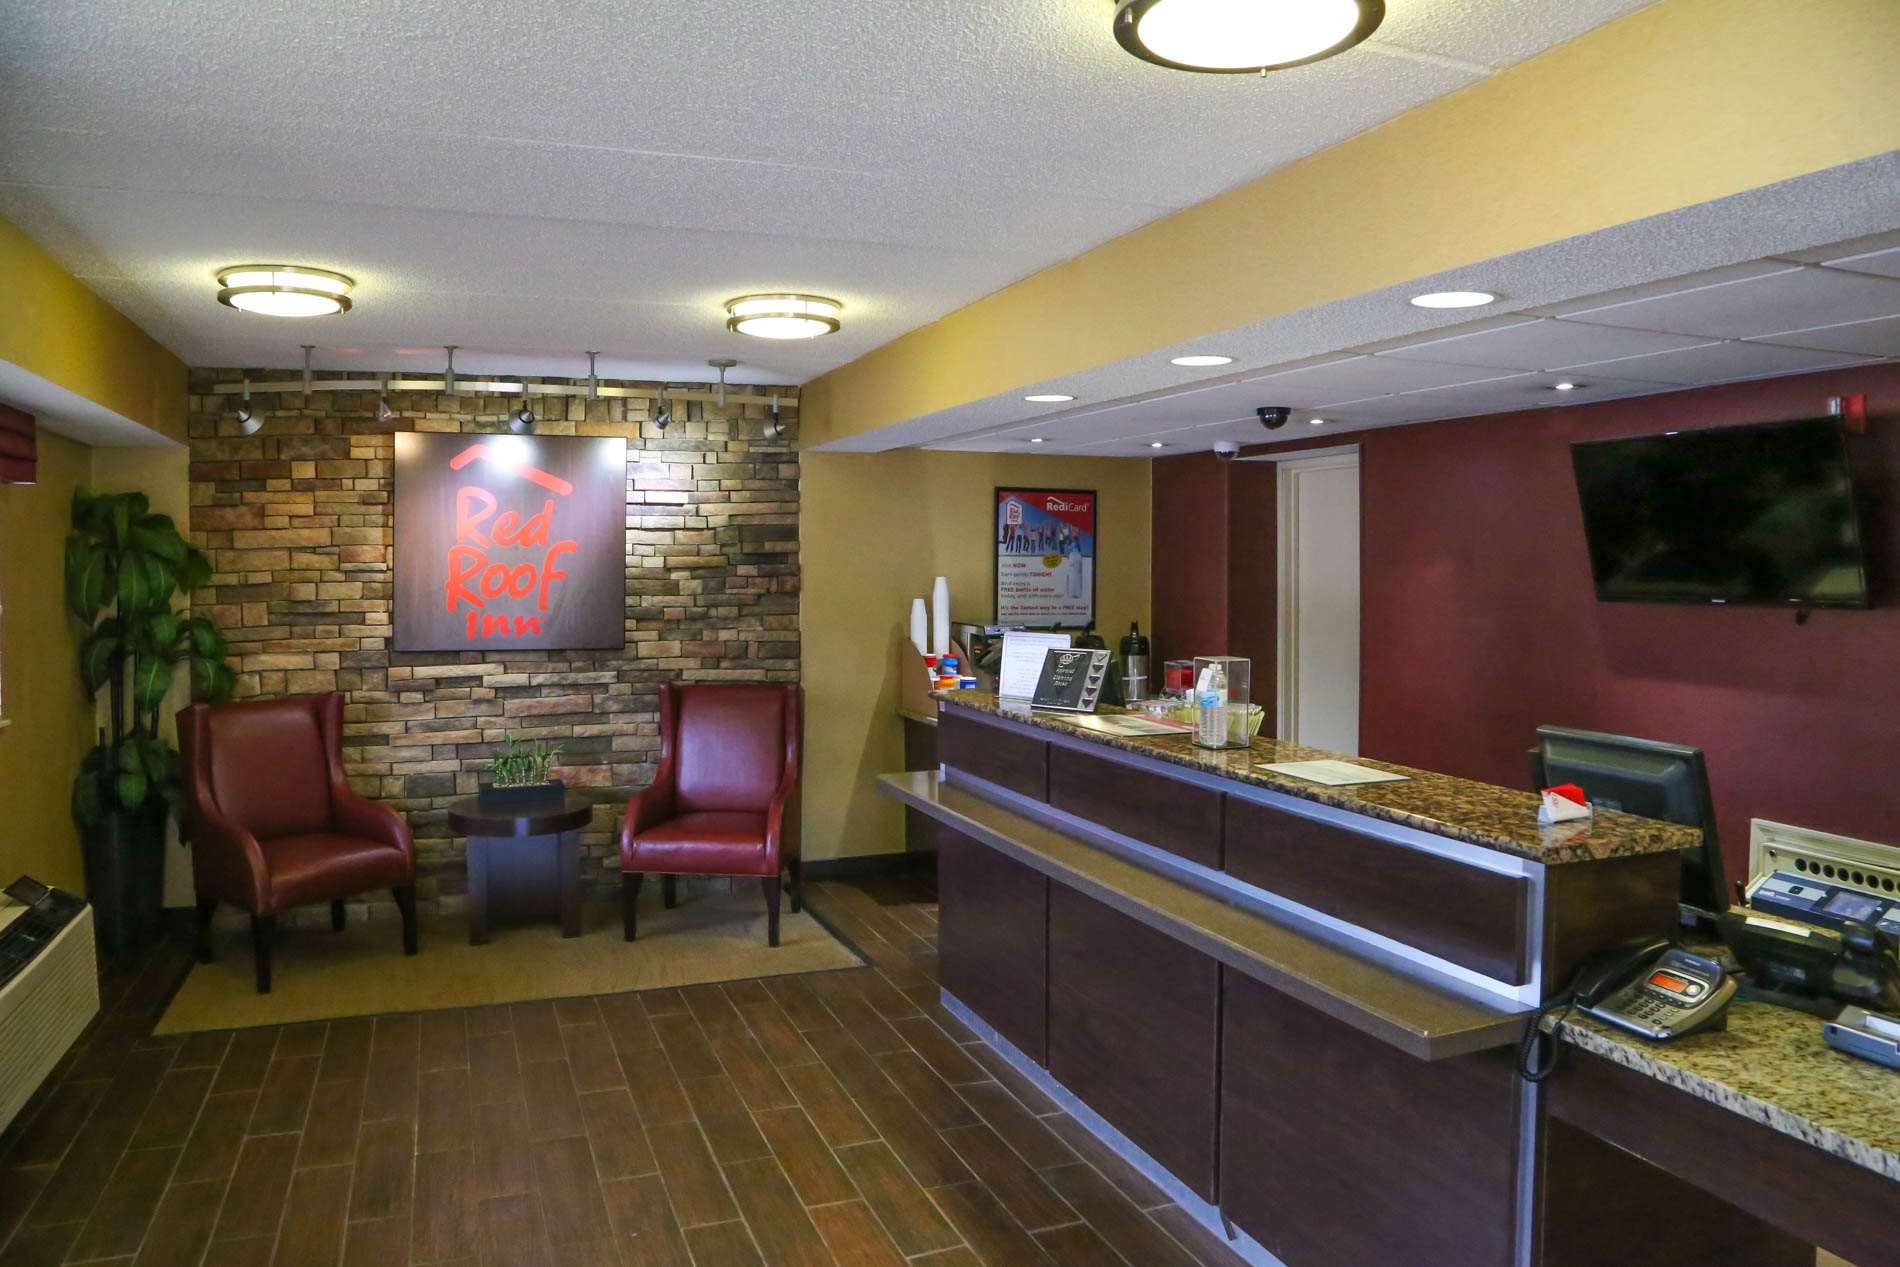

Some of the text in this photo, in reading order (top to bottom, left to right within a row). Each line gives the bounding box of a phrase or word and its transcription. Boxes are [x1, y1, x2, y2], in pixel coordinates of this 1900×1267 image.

[456, 486, 556, 549] Red
[1047, 502, 1087, 512] RediCard
[444, 540, 577, 612] Roof
[465, 611, 543, 640] Inn
